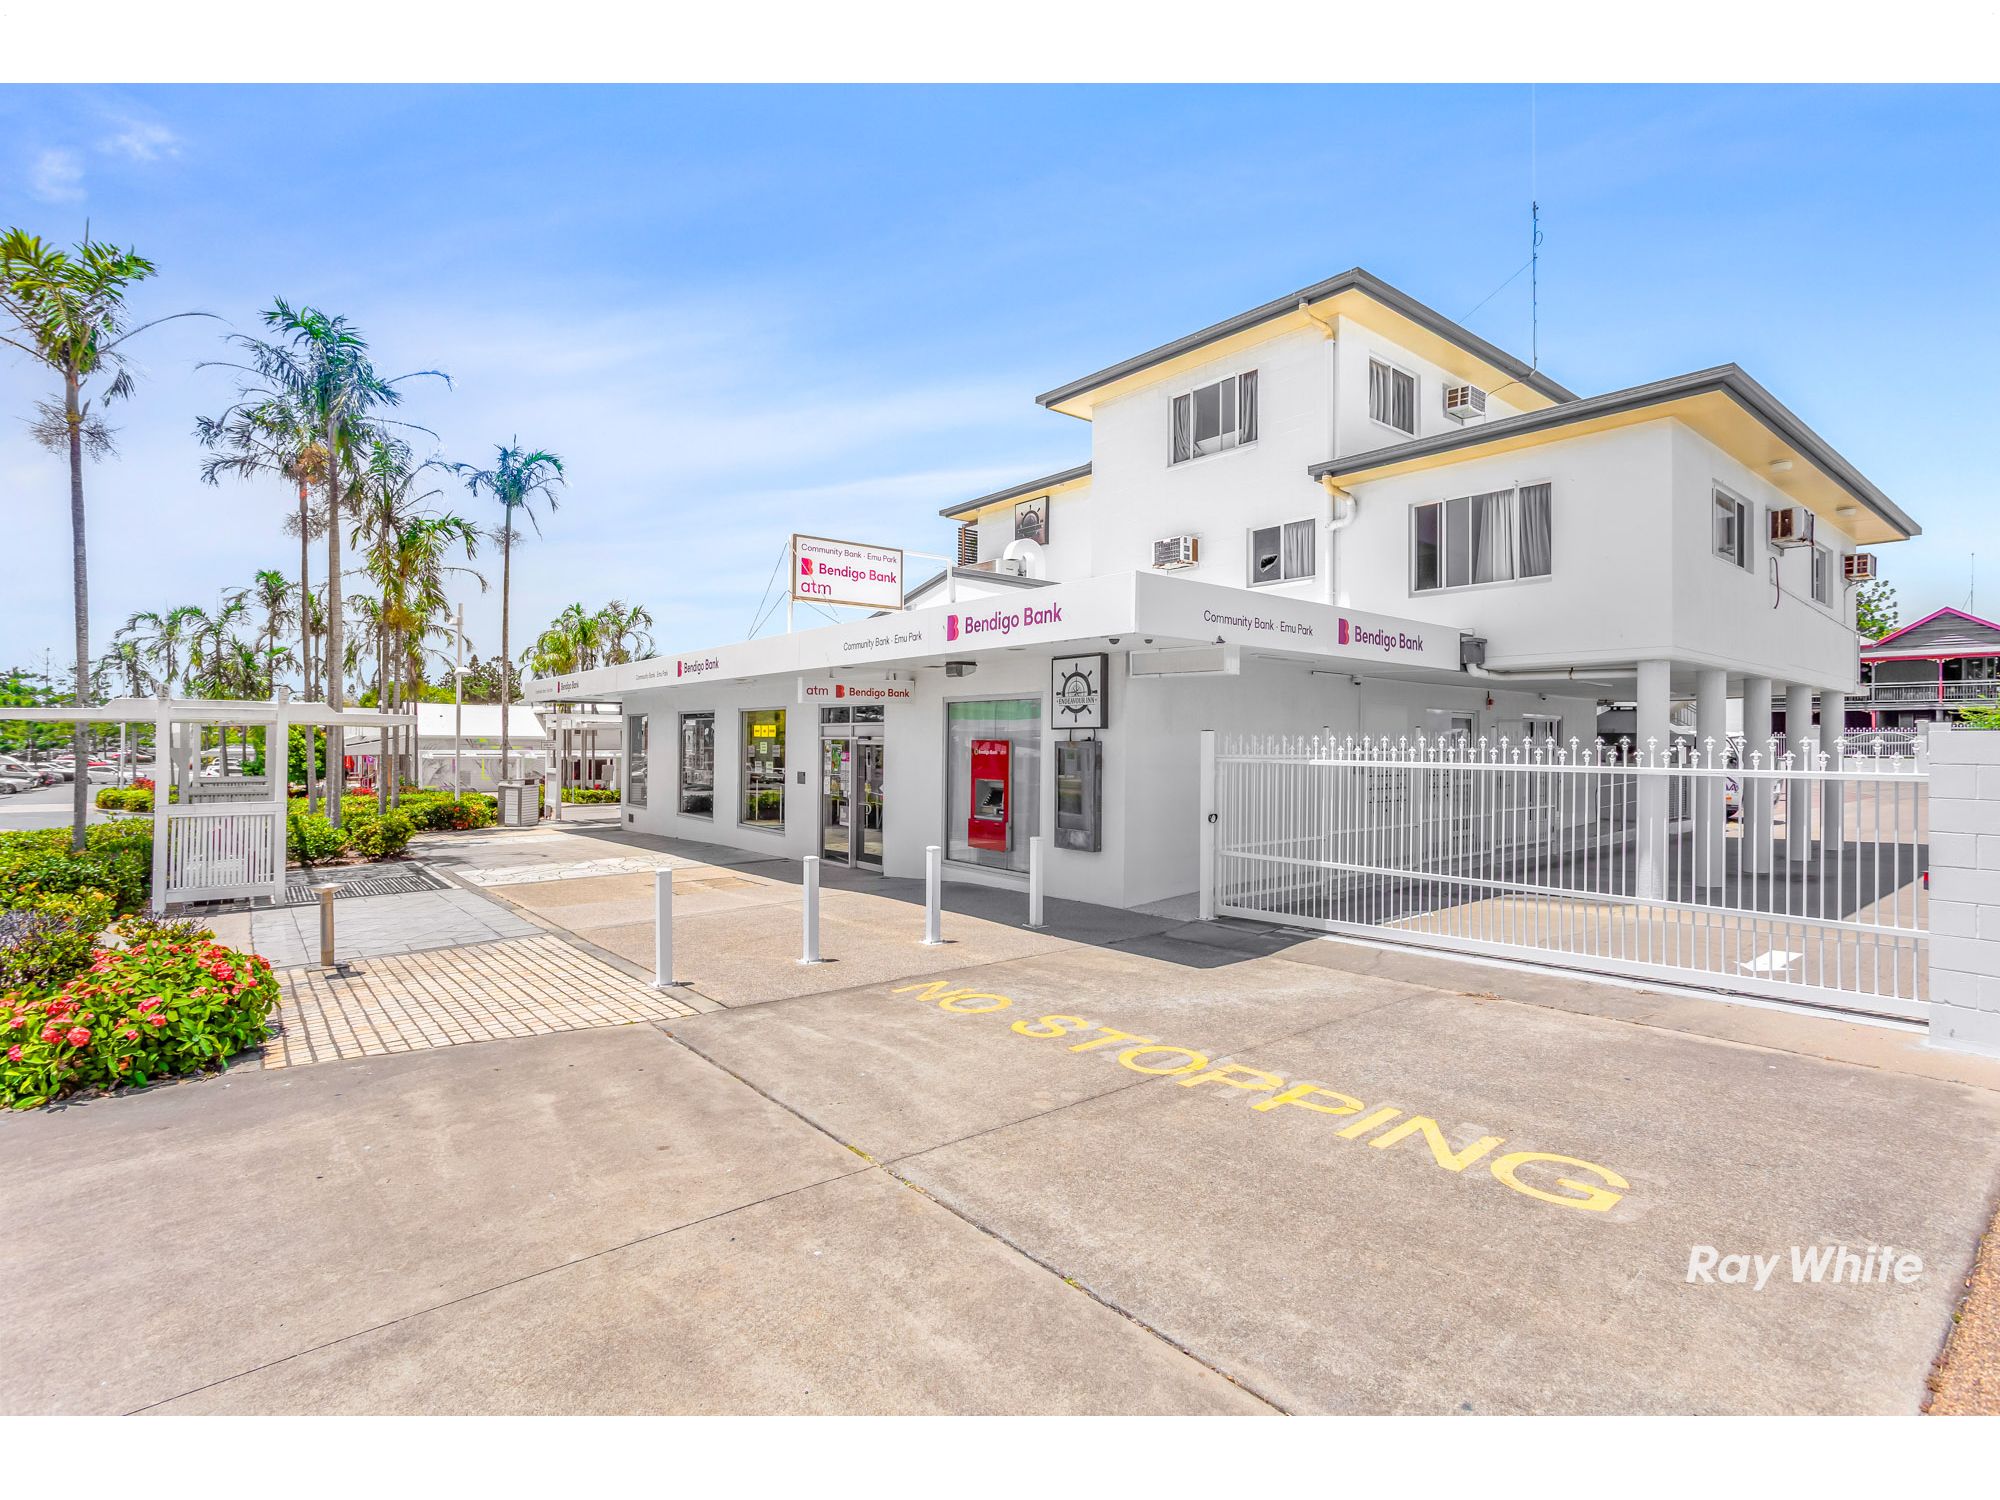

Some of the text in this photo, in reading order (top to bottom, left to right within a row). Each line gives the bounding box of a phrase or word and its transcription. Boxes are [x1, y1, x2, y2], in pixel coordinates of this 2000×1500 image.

[801, 543, 897, 564] Community Bank Emu Park
[819, 563, 866, 582] Bendigo
[869, 569, 897, 584] Bank
[801, 581, 832, 595] atm
[965, 611, 1019, 635] Bendigo
[1023, 602, 1063, 627] Bank
[1203, 610, 1314, 637] Community Bank Emu Park
[843, 630, 923, 652] Community Bank Emu Park
[1354, 625, 1397, 652] Bendigo
[1399, 632, 1424, 652] Bank
[683, 656, 720, 675] Bendigo Bank
[806, 684, 829, 697] atm
[849, 686, 886, 699] Bendigo
[888, 687, 910, 698] Bank
[891, 980, 1629, 1211] NO STOPPING
